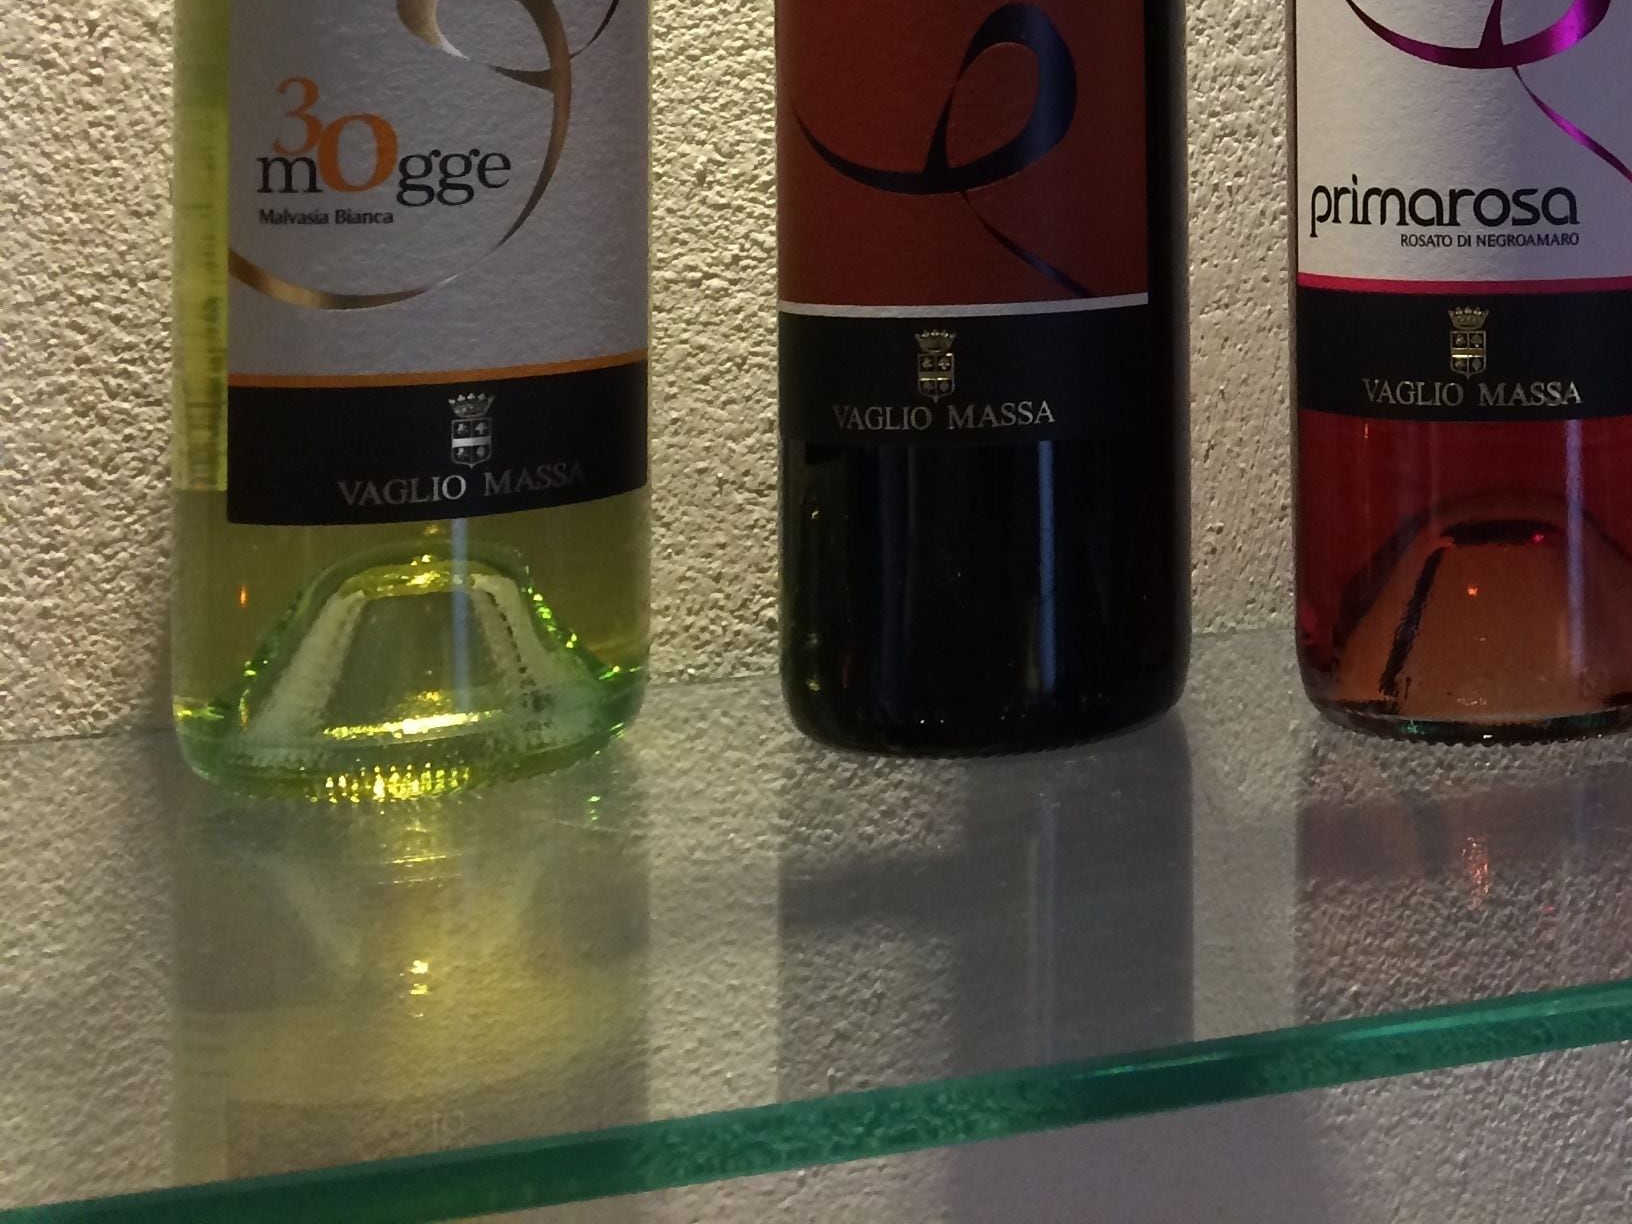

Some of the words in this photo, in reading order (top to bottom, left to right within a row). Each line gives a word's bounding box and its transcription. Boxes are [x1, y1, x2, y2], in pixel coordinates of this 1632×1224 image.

[259, 209, 329, 225] Malvasia
[335, 209, 394, 224] Bianca
[1310, 174, 1580, 238] primarosa
[1400, 234, 1453, 247] ROSATO
[1457, 235, 1472, 247] DI
[1476, 233, 1580, 246] NEGROAMARO
[1363, 378, 1464, 407] VAGLIO
[1479, 381, 1582, 406] MASSA
[833, 405, 932, 431] VAGLIO
[948, 401, 1055, 430] MASSA
[337, 475, 467, 507] VAGLIO
[484, 460, 588, 497] MASSA
